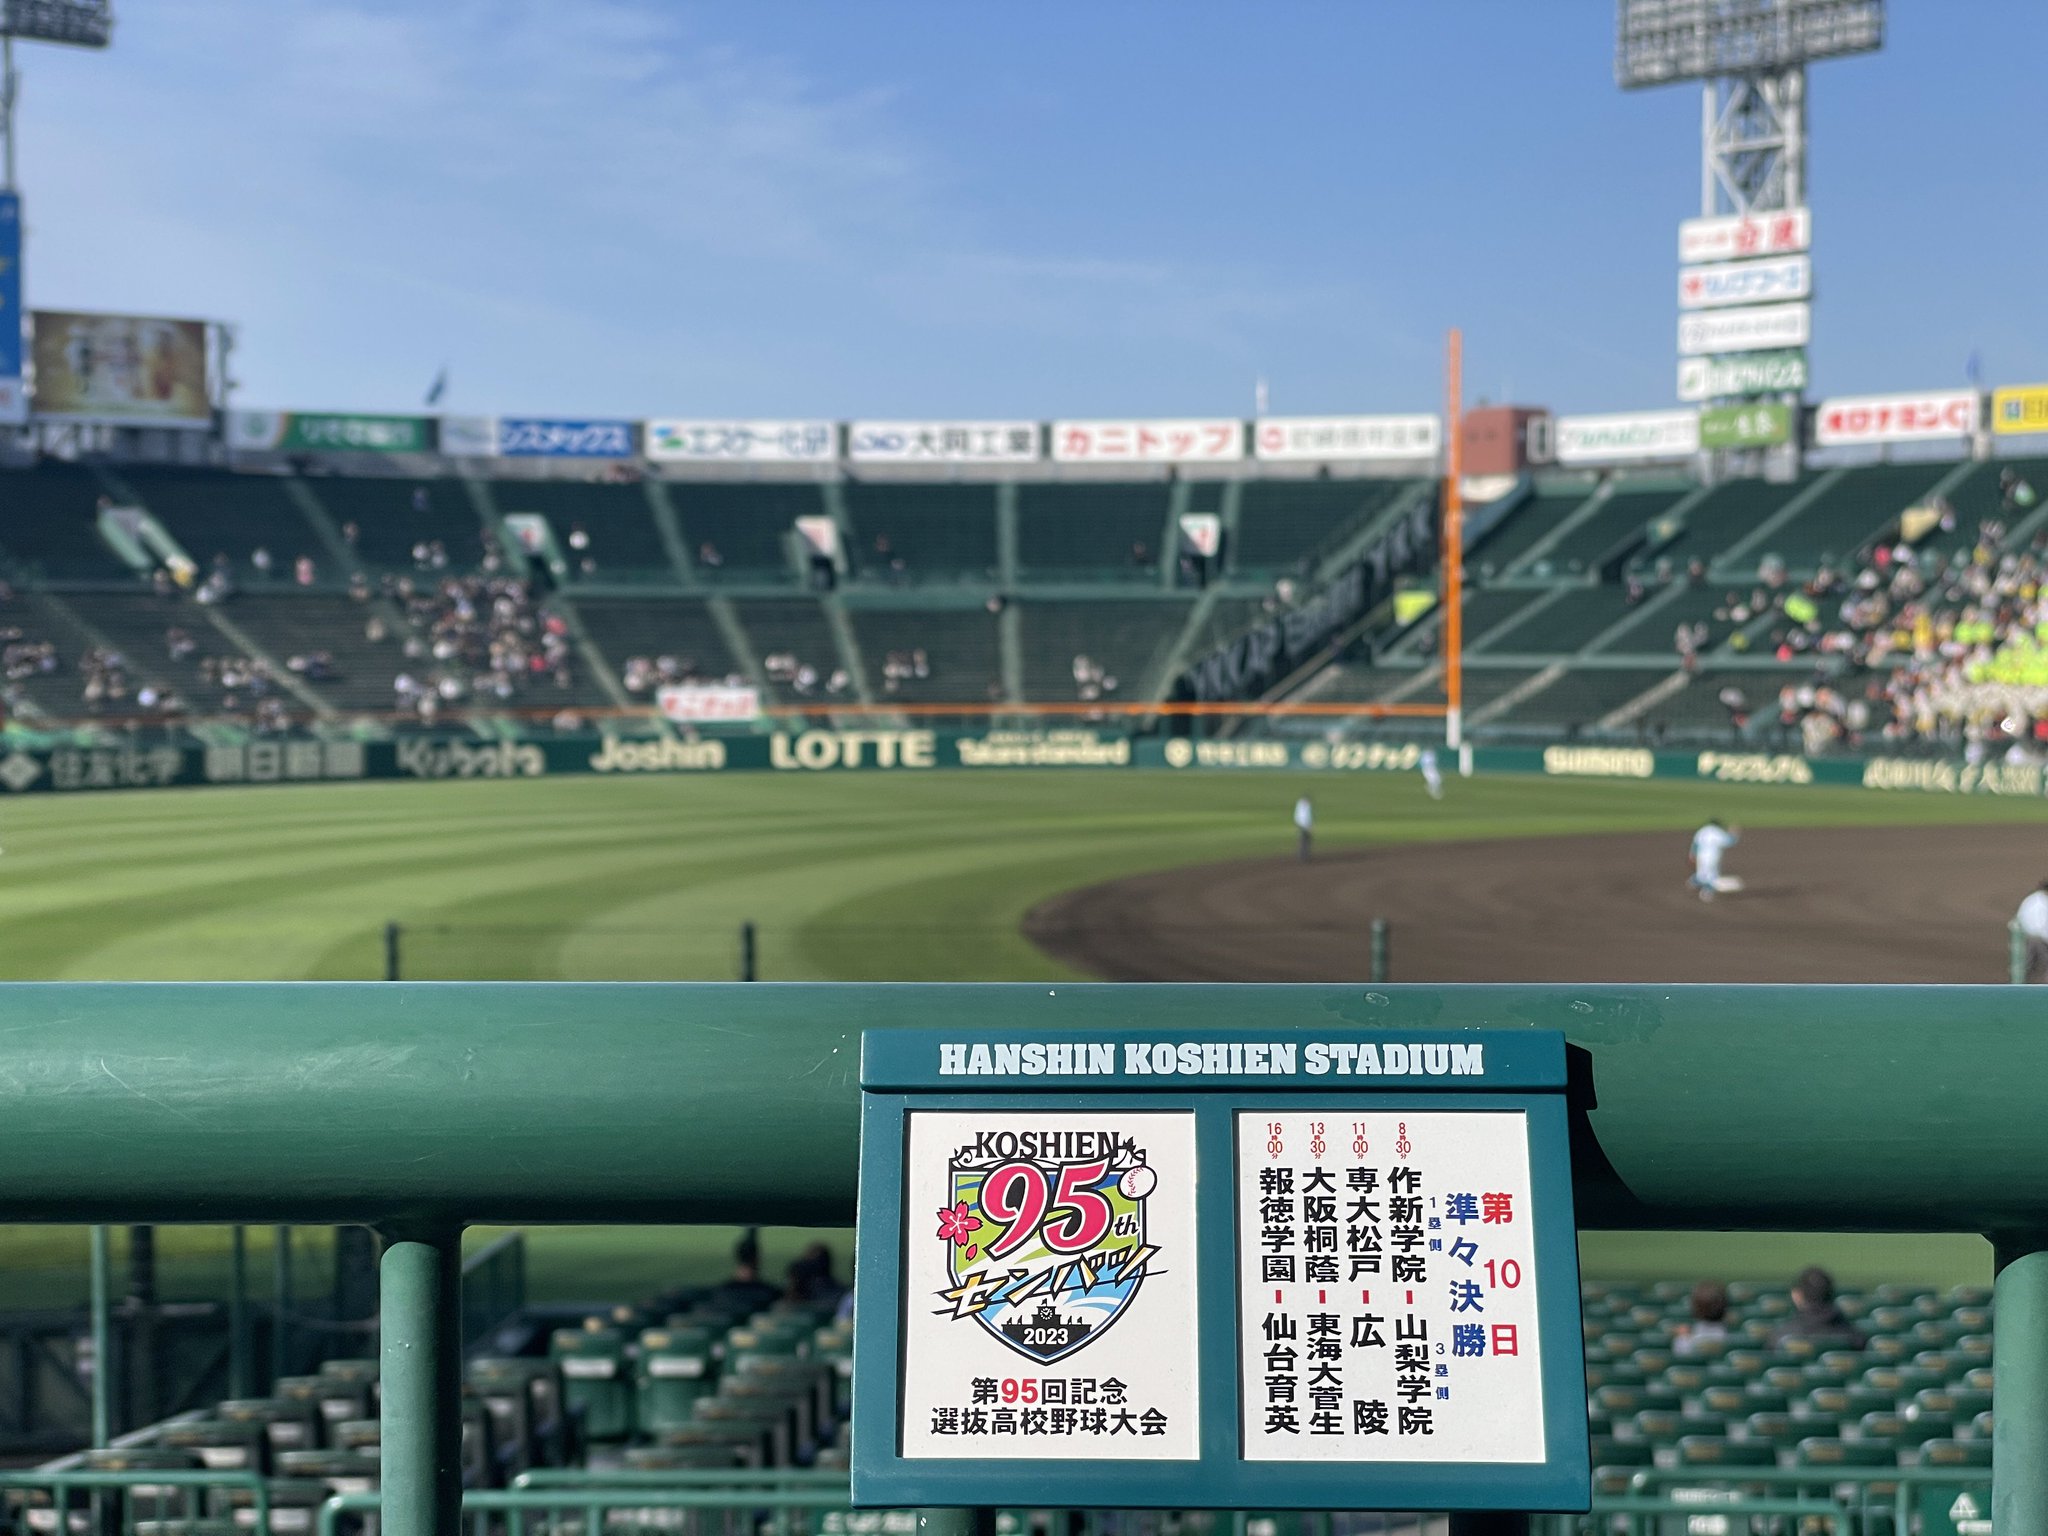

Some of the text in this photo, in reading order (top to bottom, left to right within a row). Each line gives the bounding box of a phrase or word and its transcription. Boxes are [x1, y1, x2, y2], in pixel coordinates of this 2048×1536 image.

[1062, 426, 1234, 455] カニトップ
[395, 738, 545, 778] Kubota
[590, 733, 726, 772] Joshin
[769, 731, 937, 768] LOTTE
[939, 1043, 1484, 1075] HANSHIN KOSHIEN STADIUM
[975, 1131, 1120, 1159] KOSHIEN
[1259, 1167, 1296, 1283] 報徳学園
[1302, 1166, 1340, 1283] 大阪桐蔭
[1346, 1166, 1383, 1282] 専大松戸
[1387, 1166, 1428, 1283] 作新学院
[1428, 1196, 1443, 1252] 1塁側
[934, 1243, 1166, 1321] センバツ
[1445, 1193, 1486, 1357] 準々決勝
[1023, 1328, 1069, 1345] 2023
[971, 1377, 1129, 1405] 第95回記念
[1261, 1312, 1301, 1435] 仙台育英
[1306, 1312, 1345, 1436] 東海大菅生
[1394, 1313, 1434, 1436] 山梨学院
[1434, 1342, 1450, 1400] 3塁側
[930, 1406, 1169, 1436] 選抜高校野球大会
